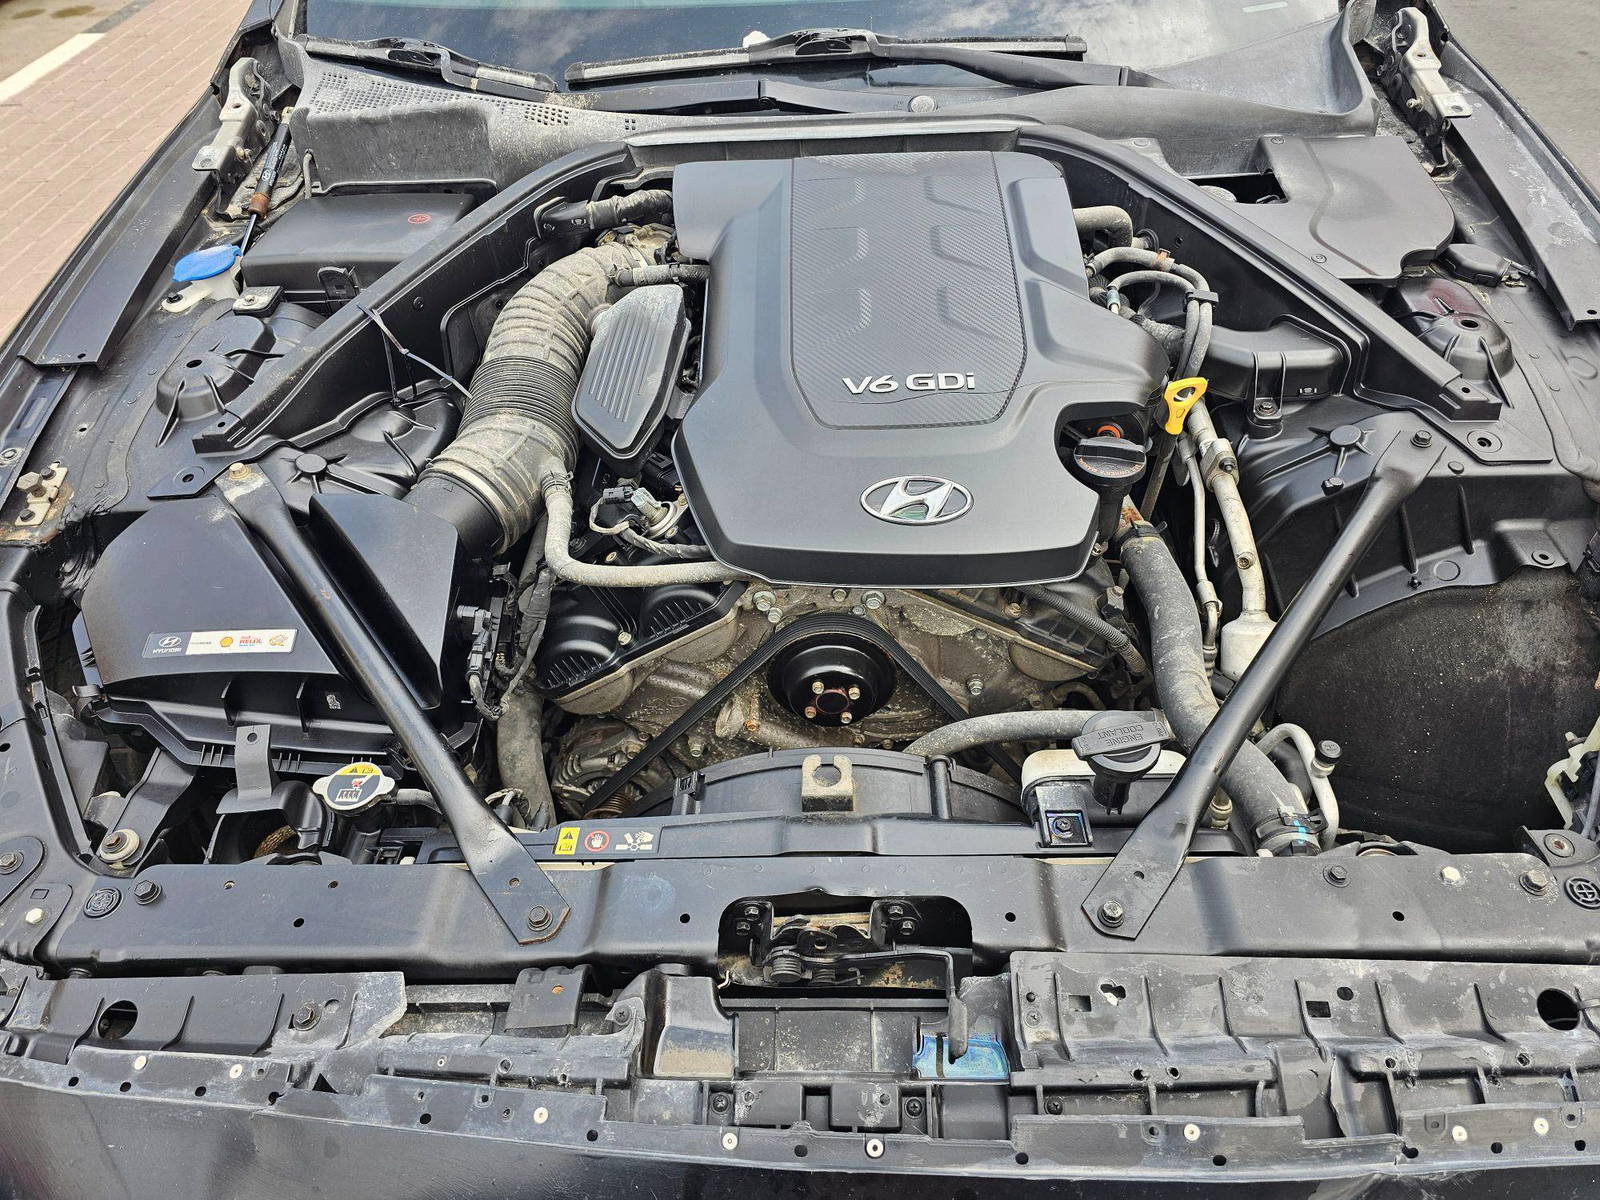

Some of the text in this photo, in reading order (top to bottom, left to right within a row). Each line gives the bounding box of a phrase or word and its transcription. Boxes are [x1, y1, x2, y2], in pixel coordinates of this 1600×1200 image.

[842, 372, 976, 395] V6 GDi
[152, 647, 183, 655] HYUNDAI
[1097, 725, 1144, 740] COOLANT
[1105, 733, 1143, 747] ENGINE
